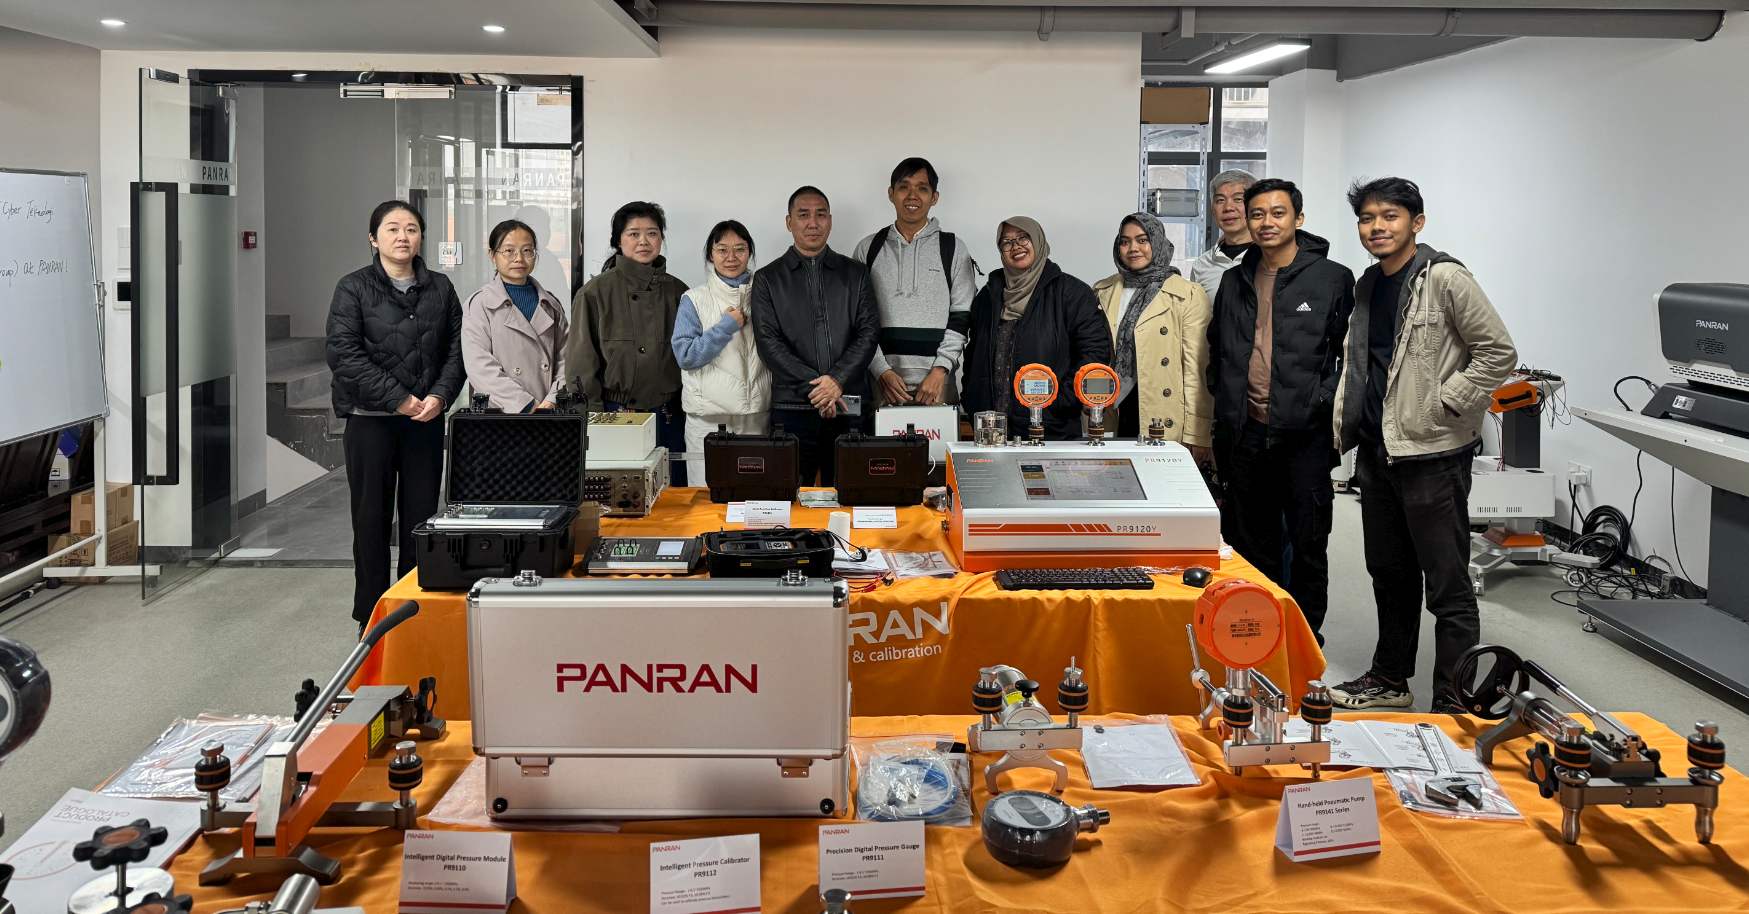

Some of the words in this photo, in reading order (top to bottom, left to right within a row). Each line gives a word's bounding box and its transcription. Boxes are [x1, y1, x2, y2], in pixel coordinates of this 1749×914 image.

[1695, 319, 1729, 331] PANRAN
[1116, 525, 1157, 533] PR9120Y
[852, 650, 866, 664] &
[869, 643, 942, 662] calibration
[555, 663, 758, 693] PANRAN
[1335, 806, 1350, 814] Series
[825, 847, 853, 855] Precision
[854, 846, 873, 854] Digital
[404, 853, 435, 862] Intelligent
[436, 854, 455, 862] Digital
[456, 854, 482, 862] Pressure
[660, 863, 691, 871] Intelligent
[692, 860, 719, 868] Pressure
[720, 857, 750, 865] Calibrator
